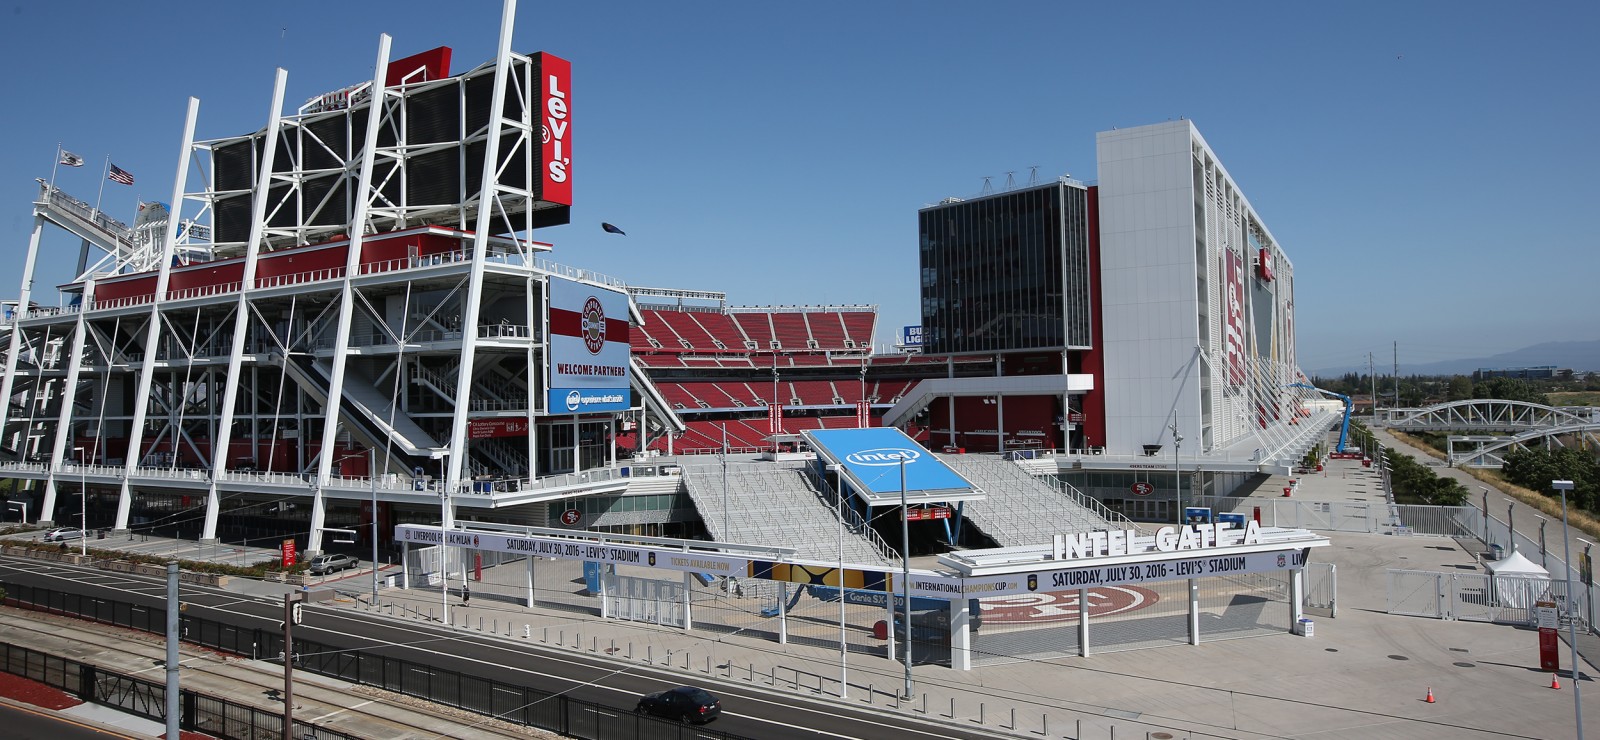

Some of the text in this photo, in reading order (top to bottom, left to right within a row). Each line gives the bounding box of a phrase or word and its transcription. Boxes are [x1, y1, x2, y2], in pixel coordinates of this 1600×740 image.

[558, 363, 626, 376] WELCOME PARTNERS
[852, 451, 911, 462] intel
[414, 531, 436, 541] LIVERPOOL
[456, 536, 470, 545] MILAN
[1053, 520, 1263, 560] INTEL GATE A
[506, 539, 538, 554] SATURDAY,
[538, 542, 552, 554] JULY
[554, 544, 564, 557] 30,
[565, 544, 580, 556] 2016
[610, 550, 640, 562] STADIUM
[671, 558, 730, 571] TICKETS AVAILABLE NOW
[1052, 570, 1102, 586] SATURDAY,
[1106, 568, 1128, 583] JULY
[1129, 566, 1144, 582] 30,
[1146, 564, 1166, 578] 2016
[1210, 557, 1246, 572] STADIUM
[901, 581, 1018, 594] WW.INTERNATIONALCHAMPIONSCUP.COM
[850, 592, 872, 602] Genie
